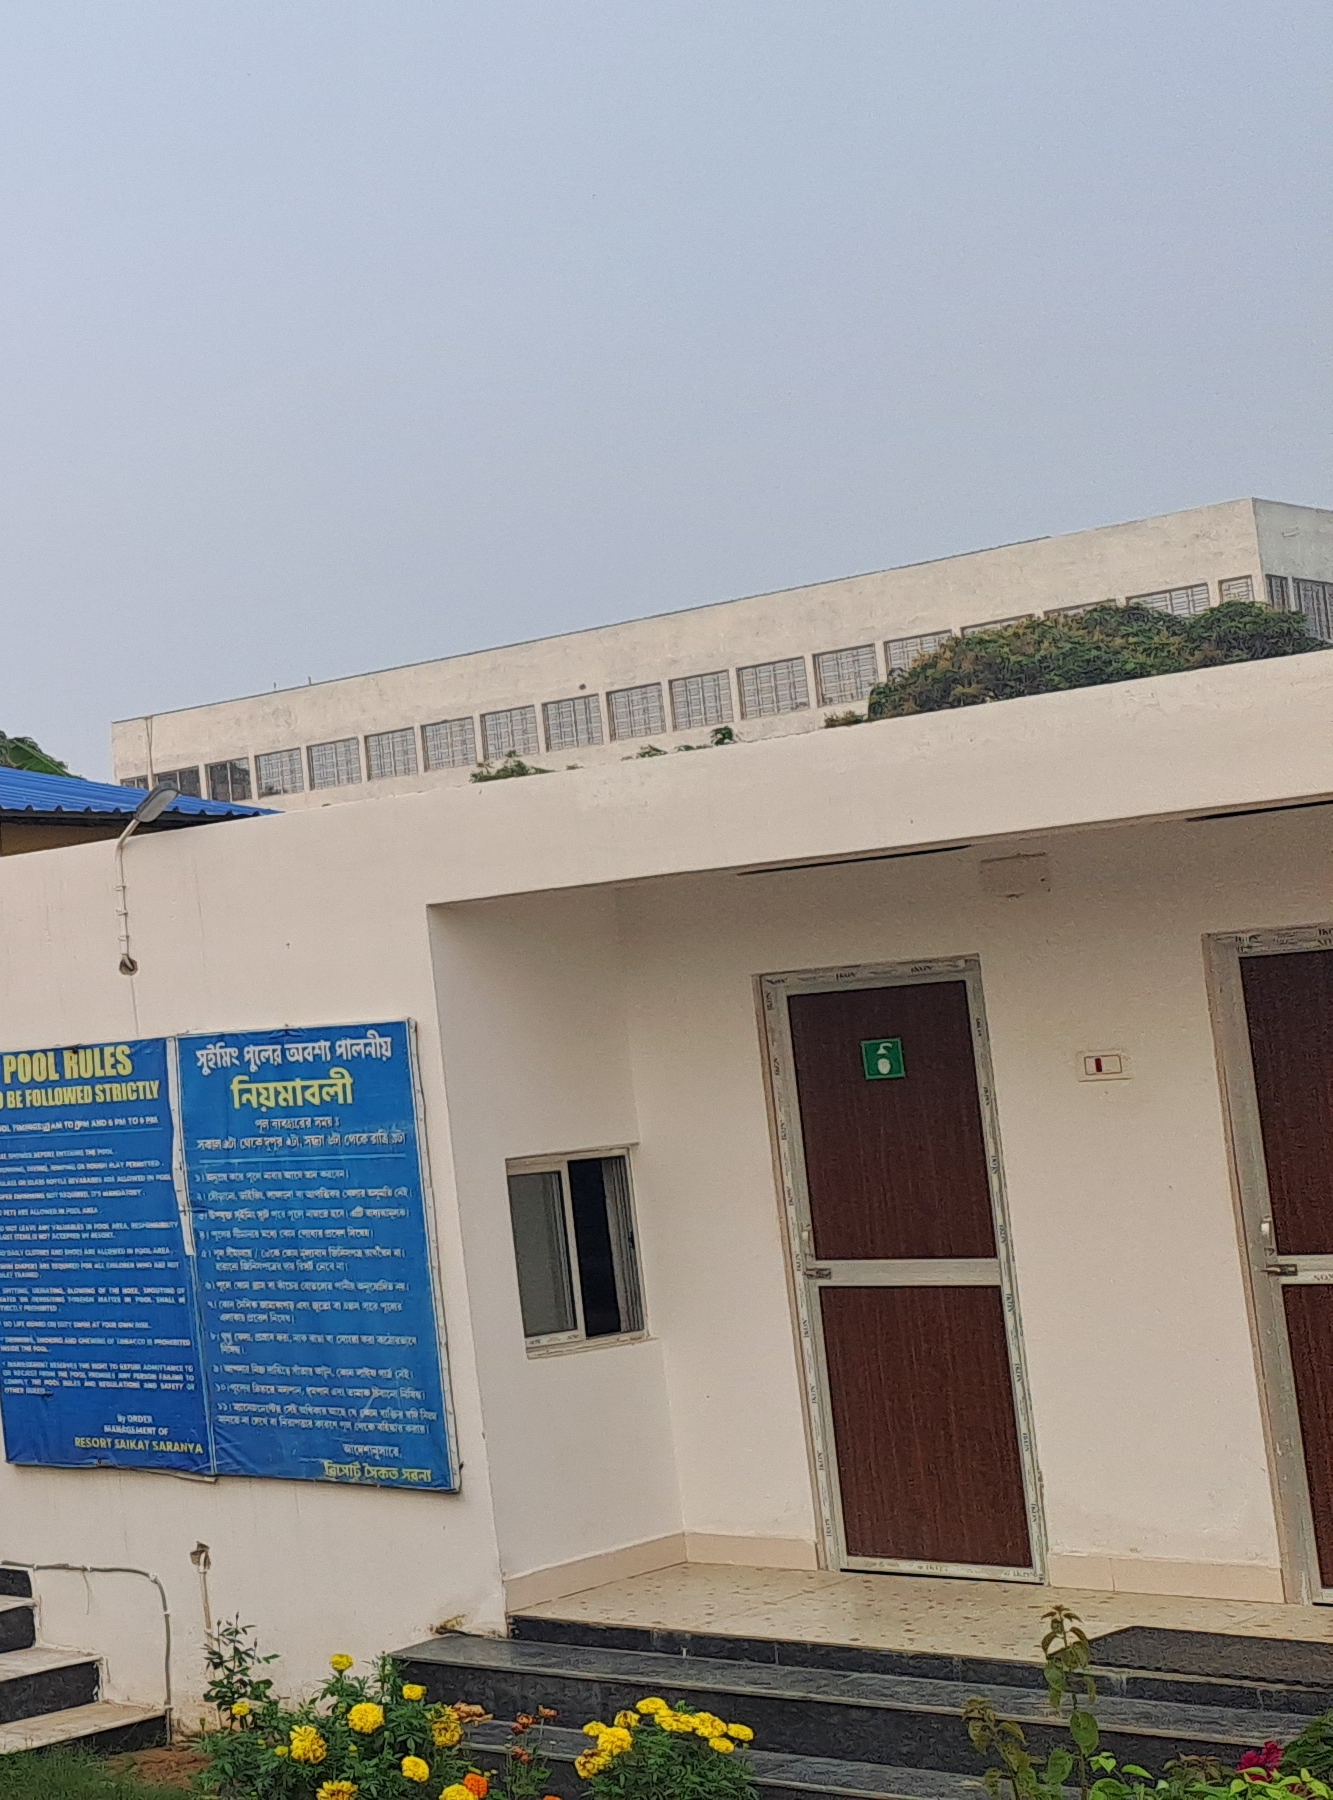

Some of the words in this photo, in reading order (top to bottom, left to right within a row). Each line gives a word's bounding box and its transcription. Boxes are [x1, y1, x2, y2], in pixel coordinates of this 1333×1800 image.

[3, 1052, 59, 1084] POOL
[63, 1044, 133, 1080] RULES
[6, 1090, 23, 1108] BE
[25, 1084, 93, 1108] FOLLOWED
[95, 1079, 160, 1104] STRICTLY
[230, 1066, 354, 1112] নিয়মাবলী
[74, 1437, 112, 1450] RESORT
[114, 1438, 150, 1451] SAIKAT
[152, 1441, 204, 1455] SARANYA
